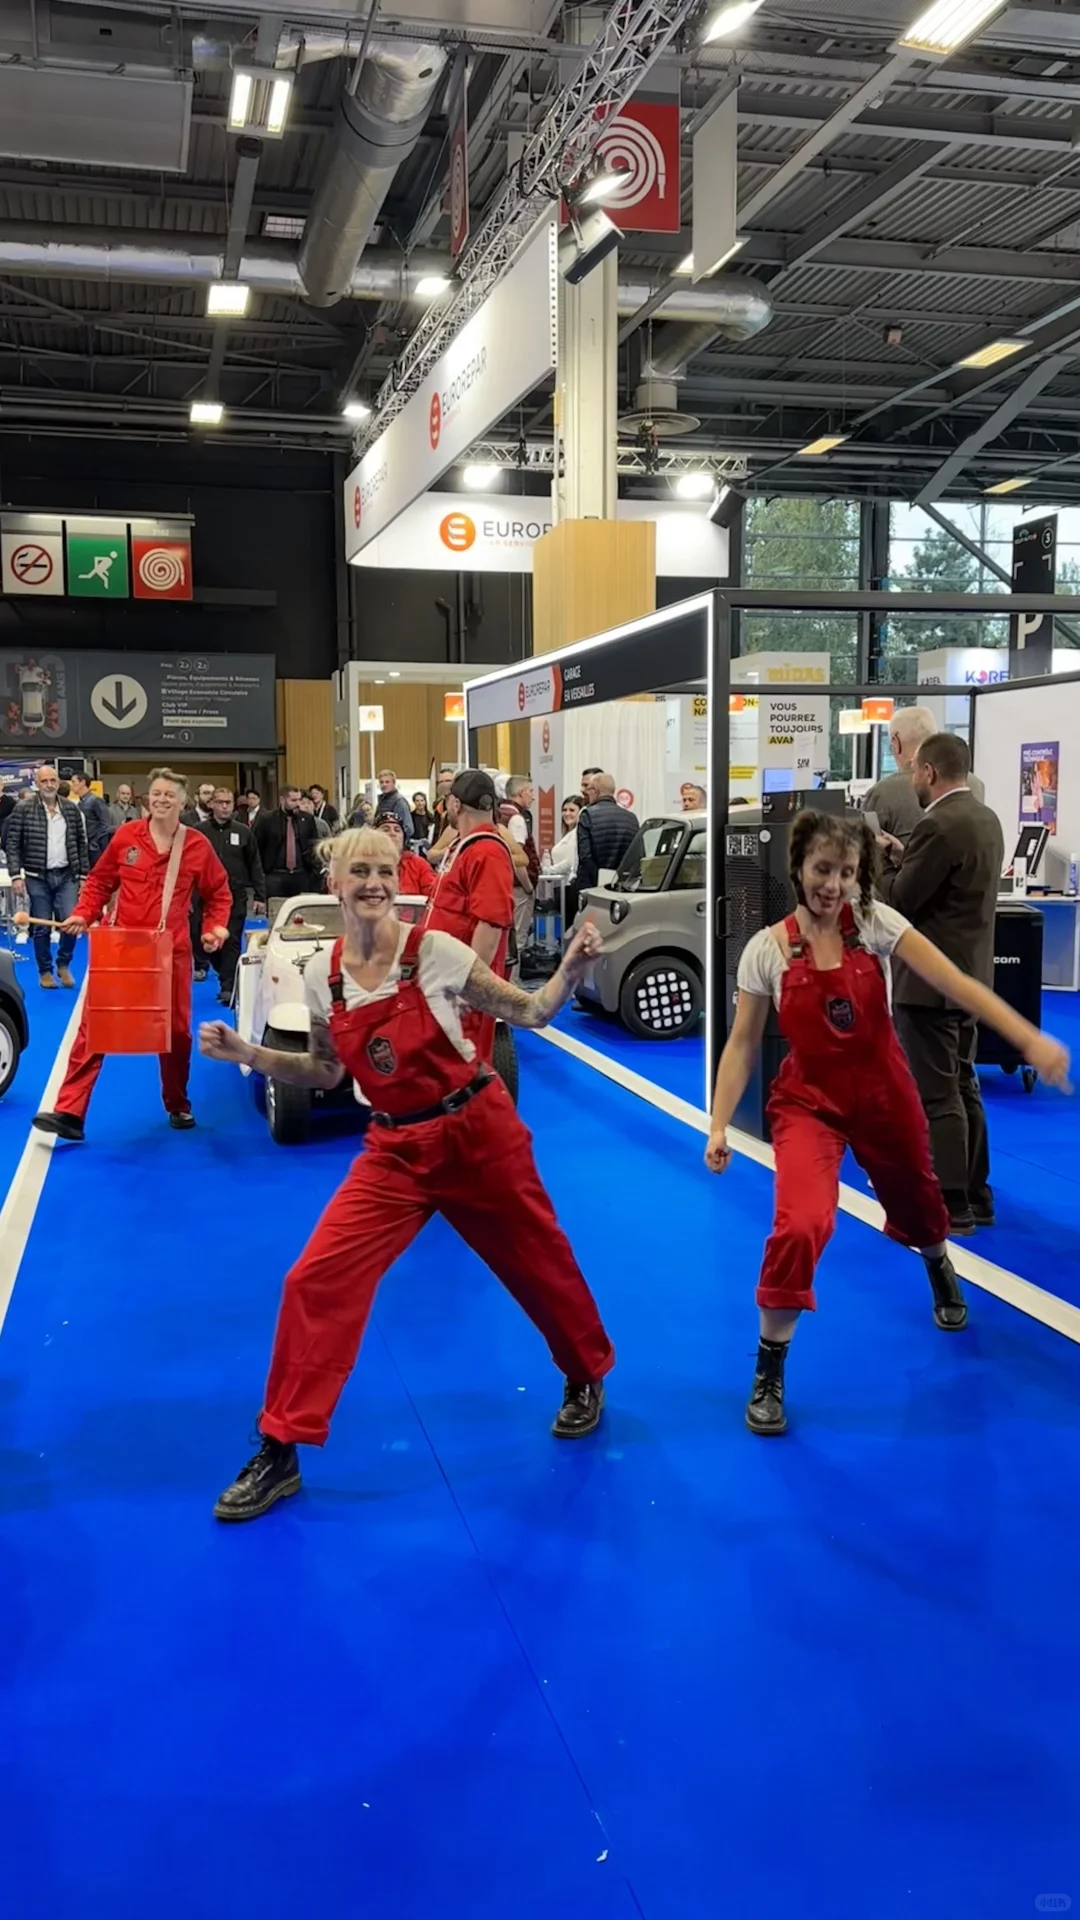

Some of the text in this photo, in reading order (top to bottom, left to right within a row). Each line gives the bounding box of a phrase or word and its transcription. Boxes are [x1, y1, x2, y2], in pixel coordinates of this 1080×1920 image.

[441, 346, 487, 416] EUROREPAR
[1044, 533, 1052, 546] 3
[1017, 614, 1044, 650] P
[563, 665, 581, 681] GARAGE
[769, 703, 797, 711] VOUS
[769, 713, 816, 722] POURREZ
[769, 725, 824, 733] TOUJOURS
